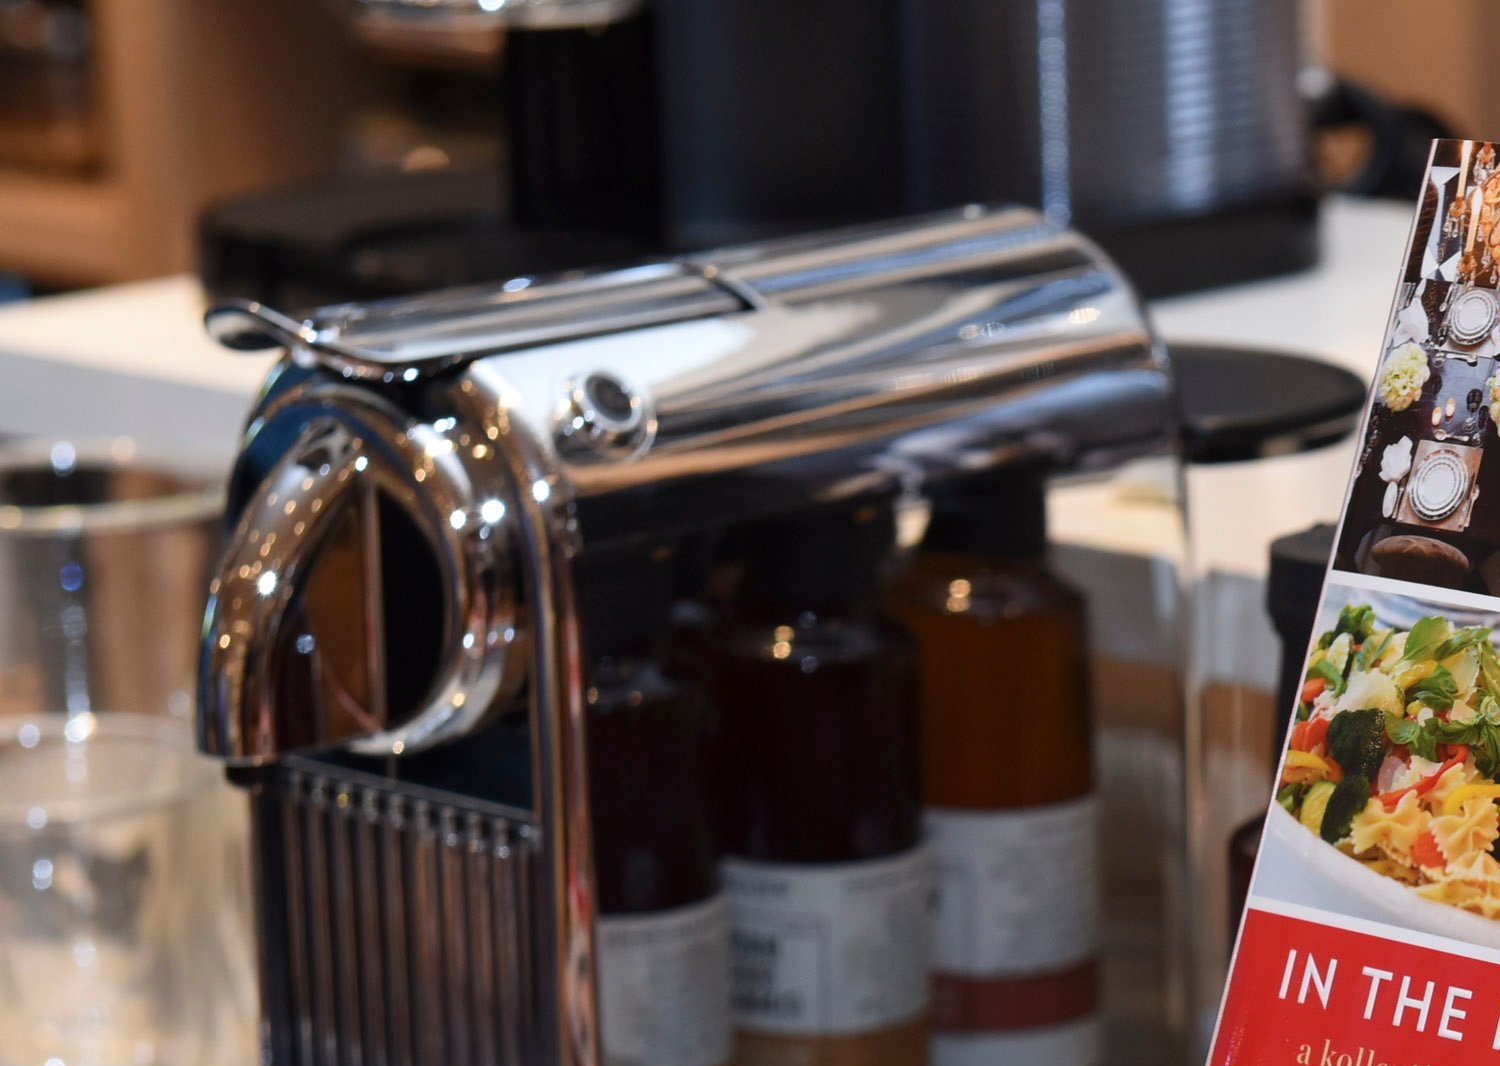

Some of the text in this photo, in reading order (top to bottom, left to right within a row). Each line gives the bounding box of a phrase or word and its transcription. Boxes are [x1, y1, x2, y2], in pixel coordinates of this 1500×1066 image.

[1278, 948, 1338, 1010] IN
[1361, 967, 1474, 1042] THE
[1296, 1044, 1312, 1066] a
